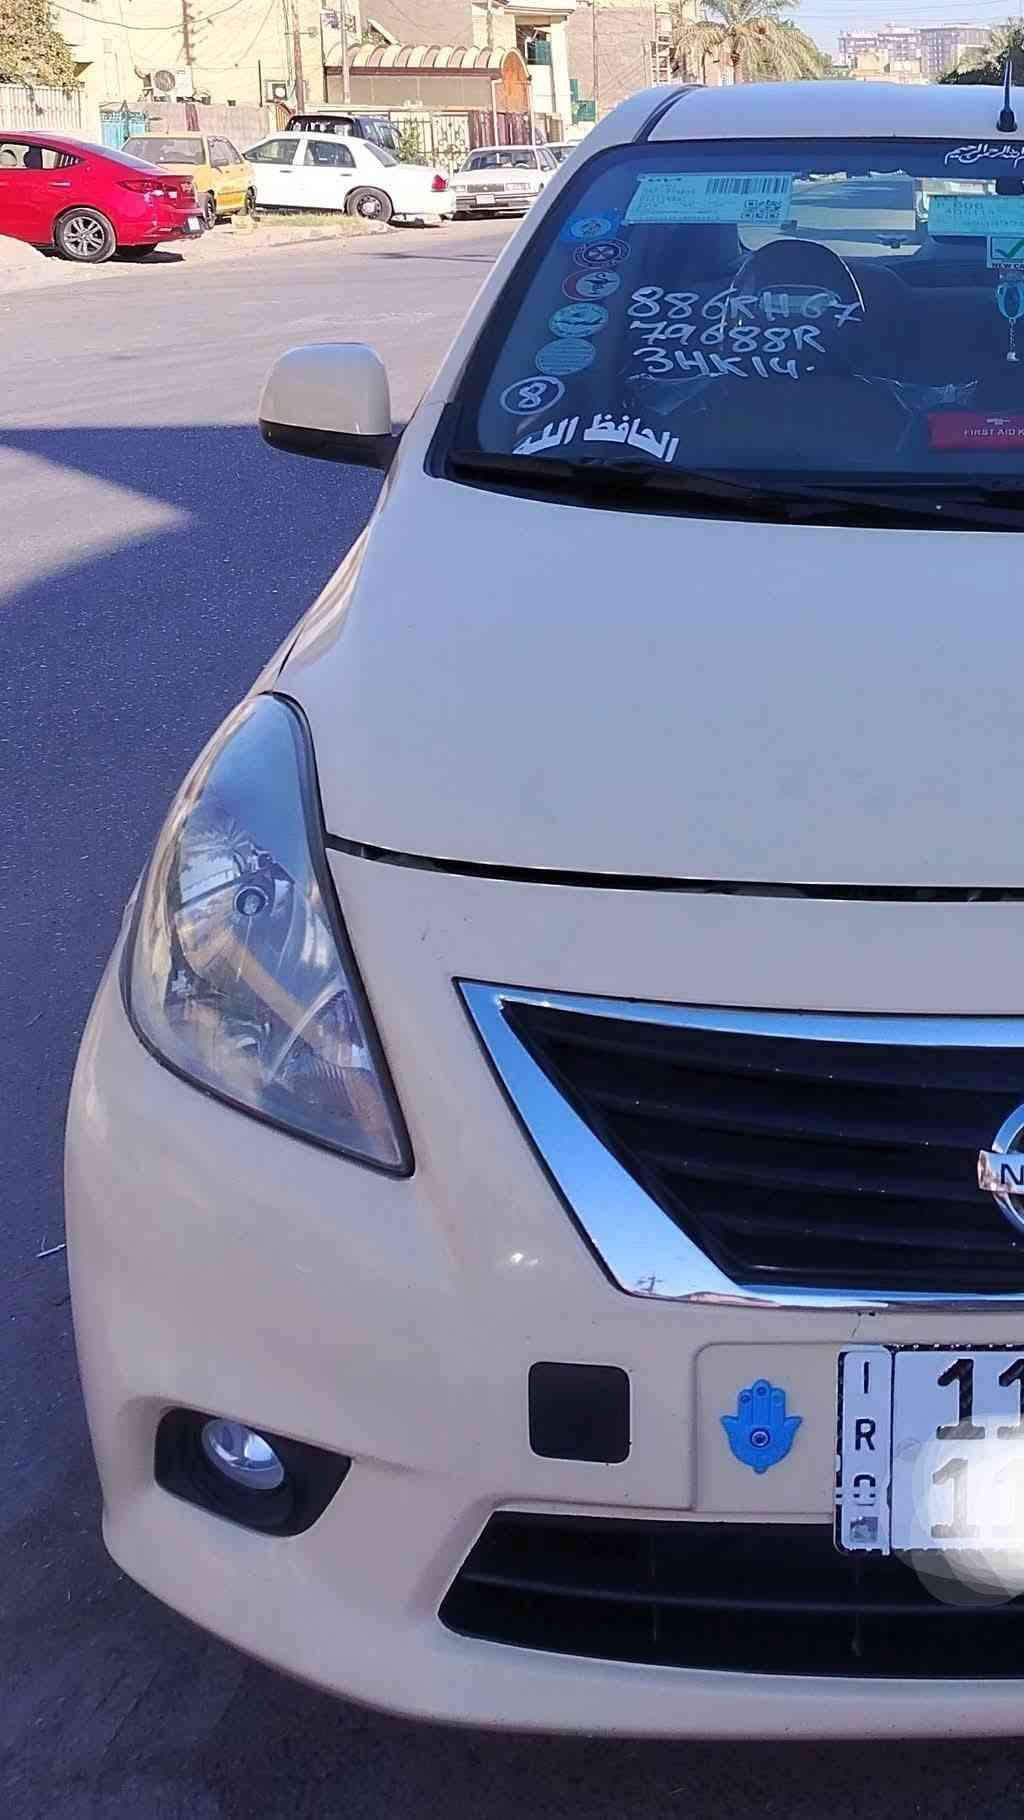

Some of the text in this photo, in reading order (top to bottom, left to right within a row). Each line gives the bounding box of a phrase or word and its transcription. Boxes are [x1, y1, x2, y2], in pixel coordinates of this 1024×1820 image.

[511, 413, 681, 463] الحافظ الله
[996, 428, 1016, 436] AID
